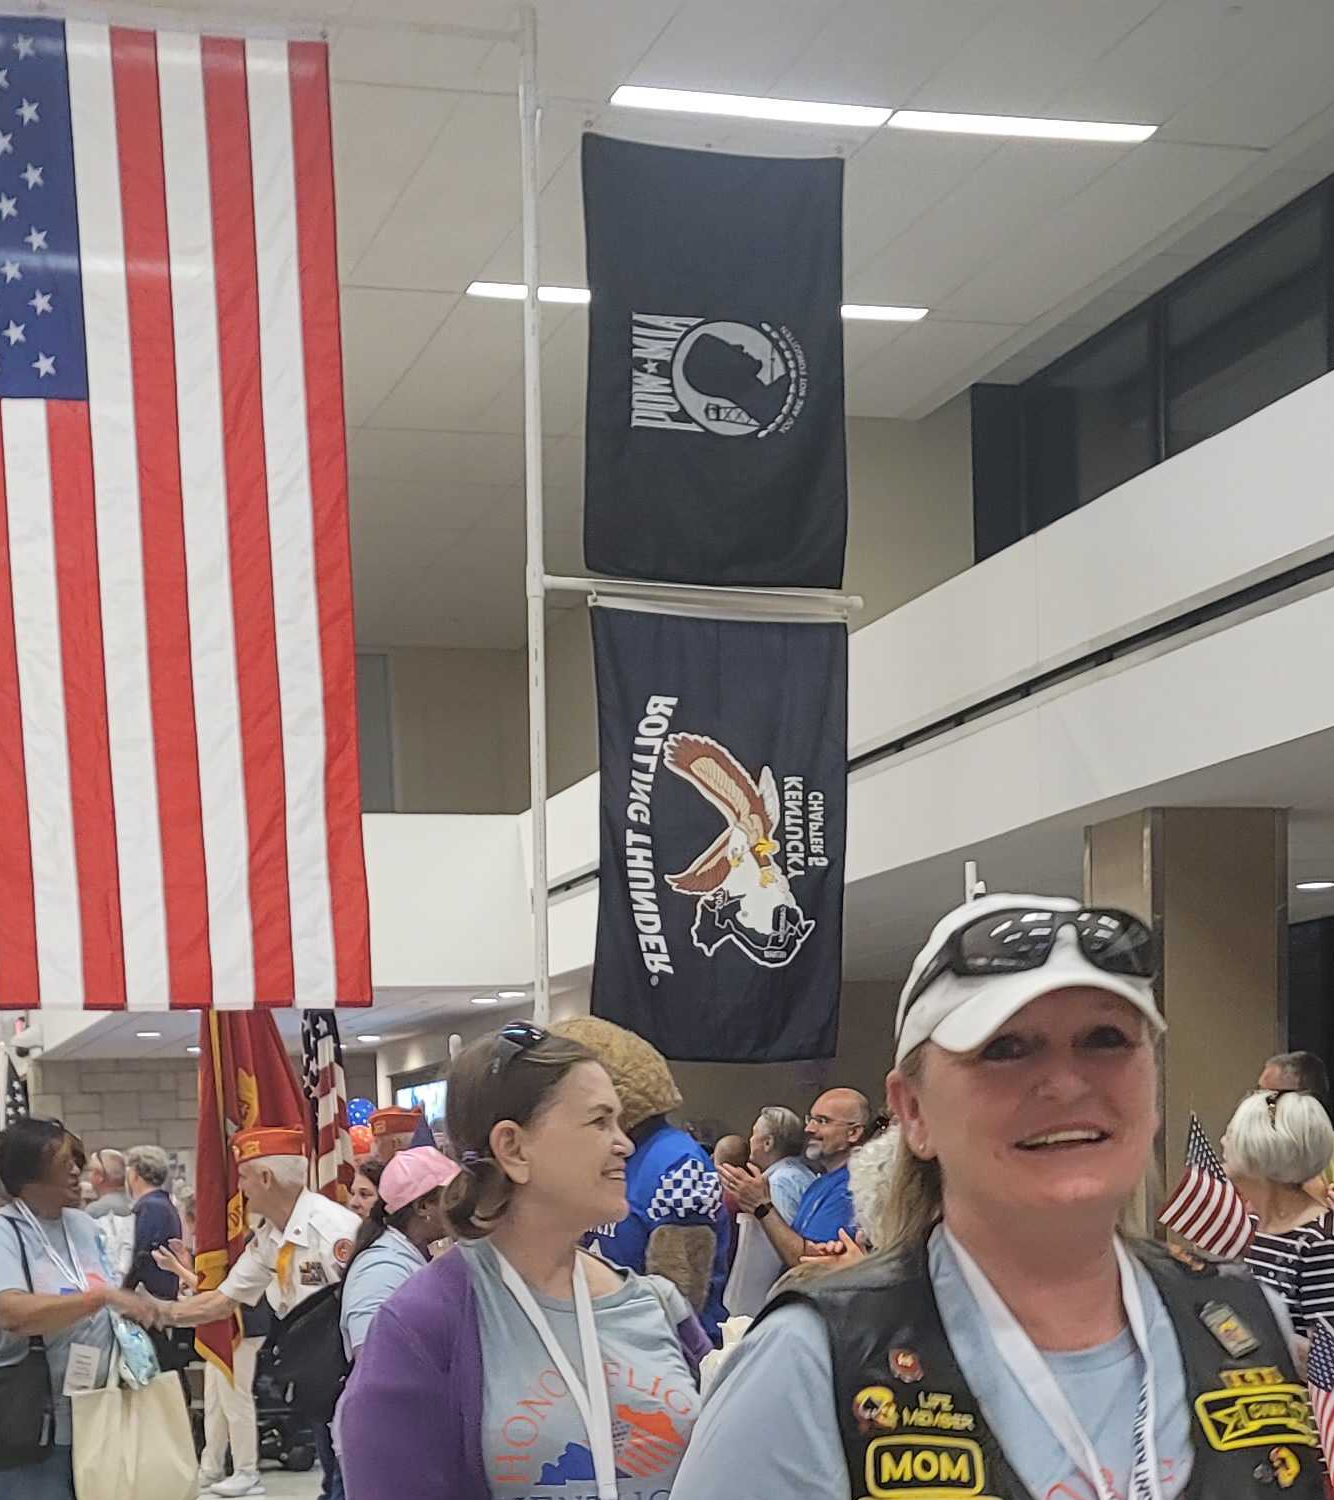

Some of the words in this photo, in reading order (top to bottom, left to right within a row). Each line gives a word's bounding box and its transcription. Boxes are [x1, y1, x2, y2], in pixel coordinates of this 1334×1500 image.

[492, 1369, 569, 1485] HONO
[602, 1360, 694, 1416] FLIG
[880, 1450, 971, 1483] MOM
